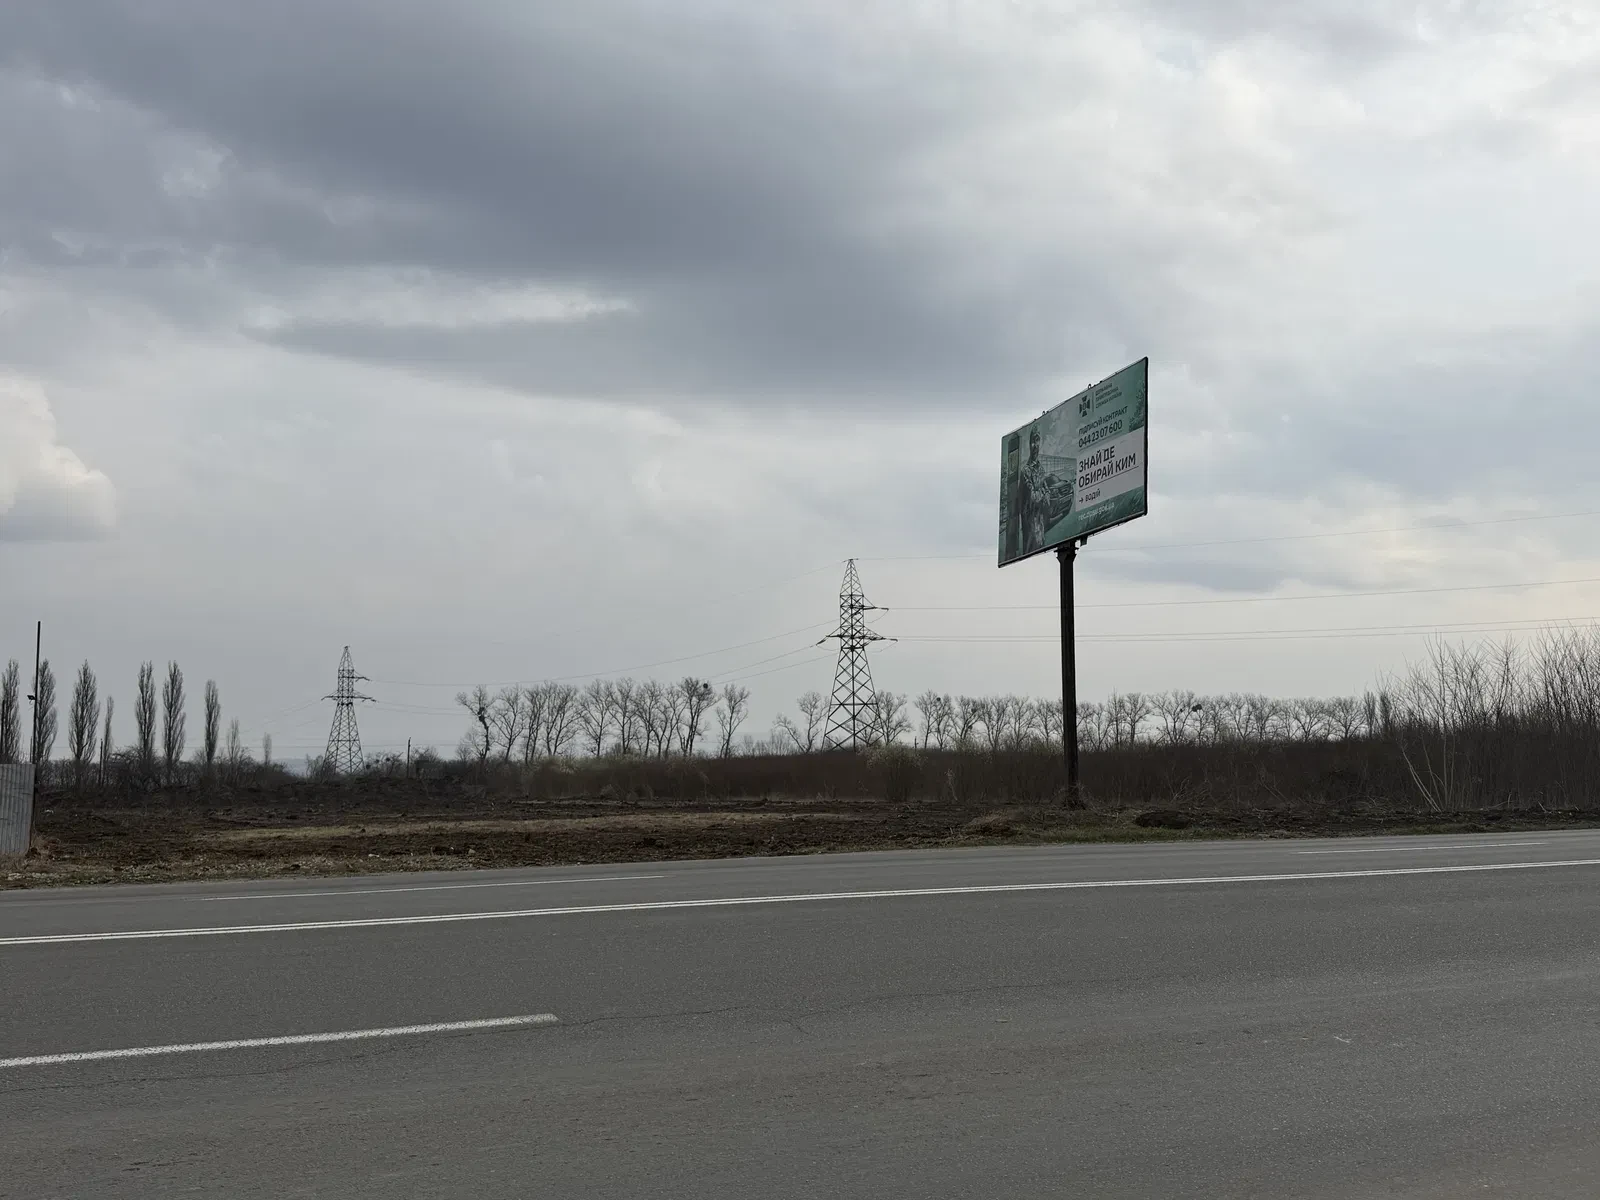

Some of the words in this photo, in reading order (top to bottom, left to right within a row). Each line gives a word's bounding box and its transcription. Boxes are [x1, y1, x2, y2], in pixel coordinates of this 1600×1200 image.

[1103, 406, 1128, 423] КОНТРАКТ
[1079, 450, 1102, 472] ЗНАЙ
[1103, 446, 1115, 462] ДЕ
[1079, 460, 1113, 488] ОБИРАЙ
[1115, 453, 1136, 473] КИМ
